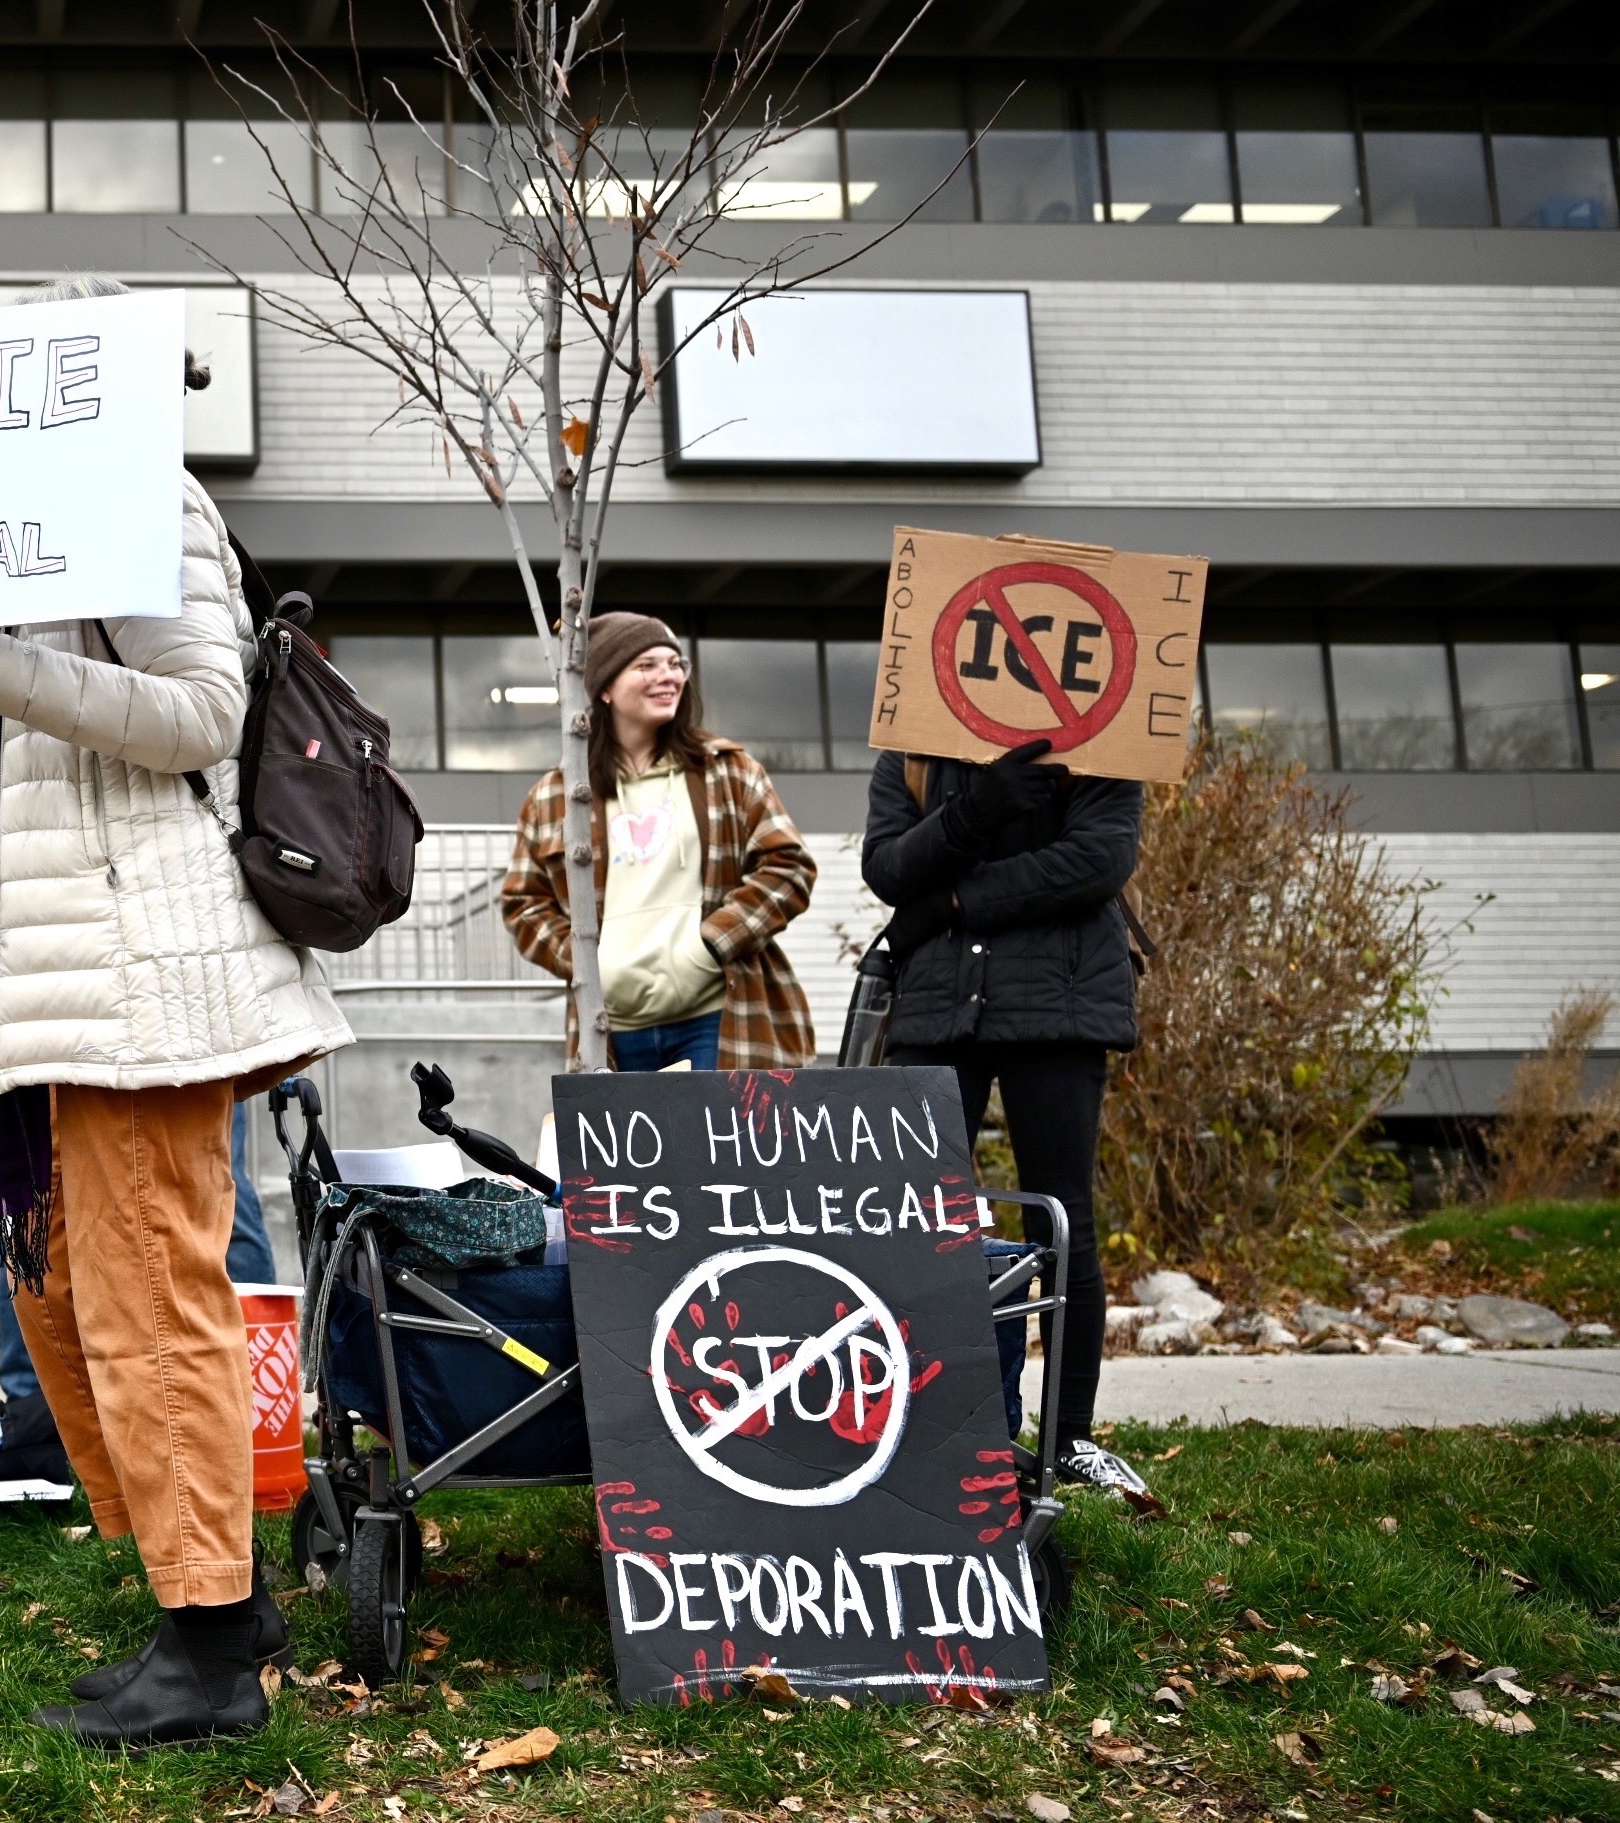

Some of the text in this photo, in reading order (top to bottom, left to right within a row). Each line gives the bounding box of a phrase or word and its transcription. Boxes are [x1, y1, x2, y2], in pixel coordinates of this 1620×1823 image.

[877, 538, 917, 726] ABOLISH
[959, 608, 1104, 694] ICE
[1148, 570, 1194, 737] ICE
[578, 1094, 939, 1170] NO HUMAN
[582, 1182, 970, 1241] IS ILLEGAL
[252, 1325, 298, 1431] HOM
[263, 1385, 298, 1438] THE
[692, 1333, 896, 1431] STOP
[615, 1541, 1044, 1640] DEPORATION
